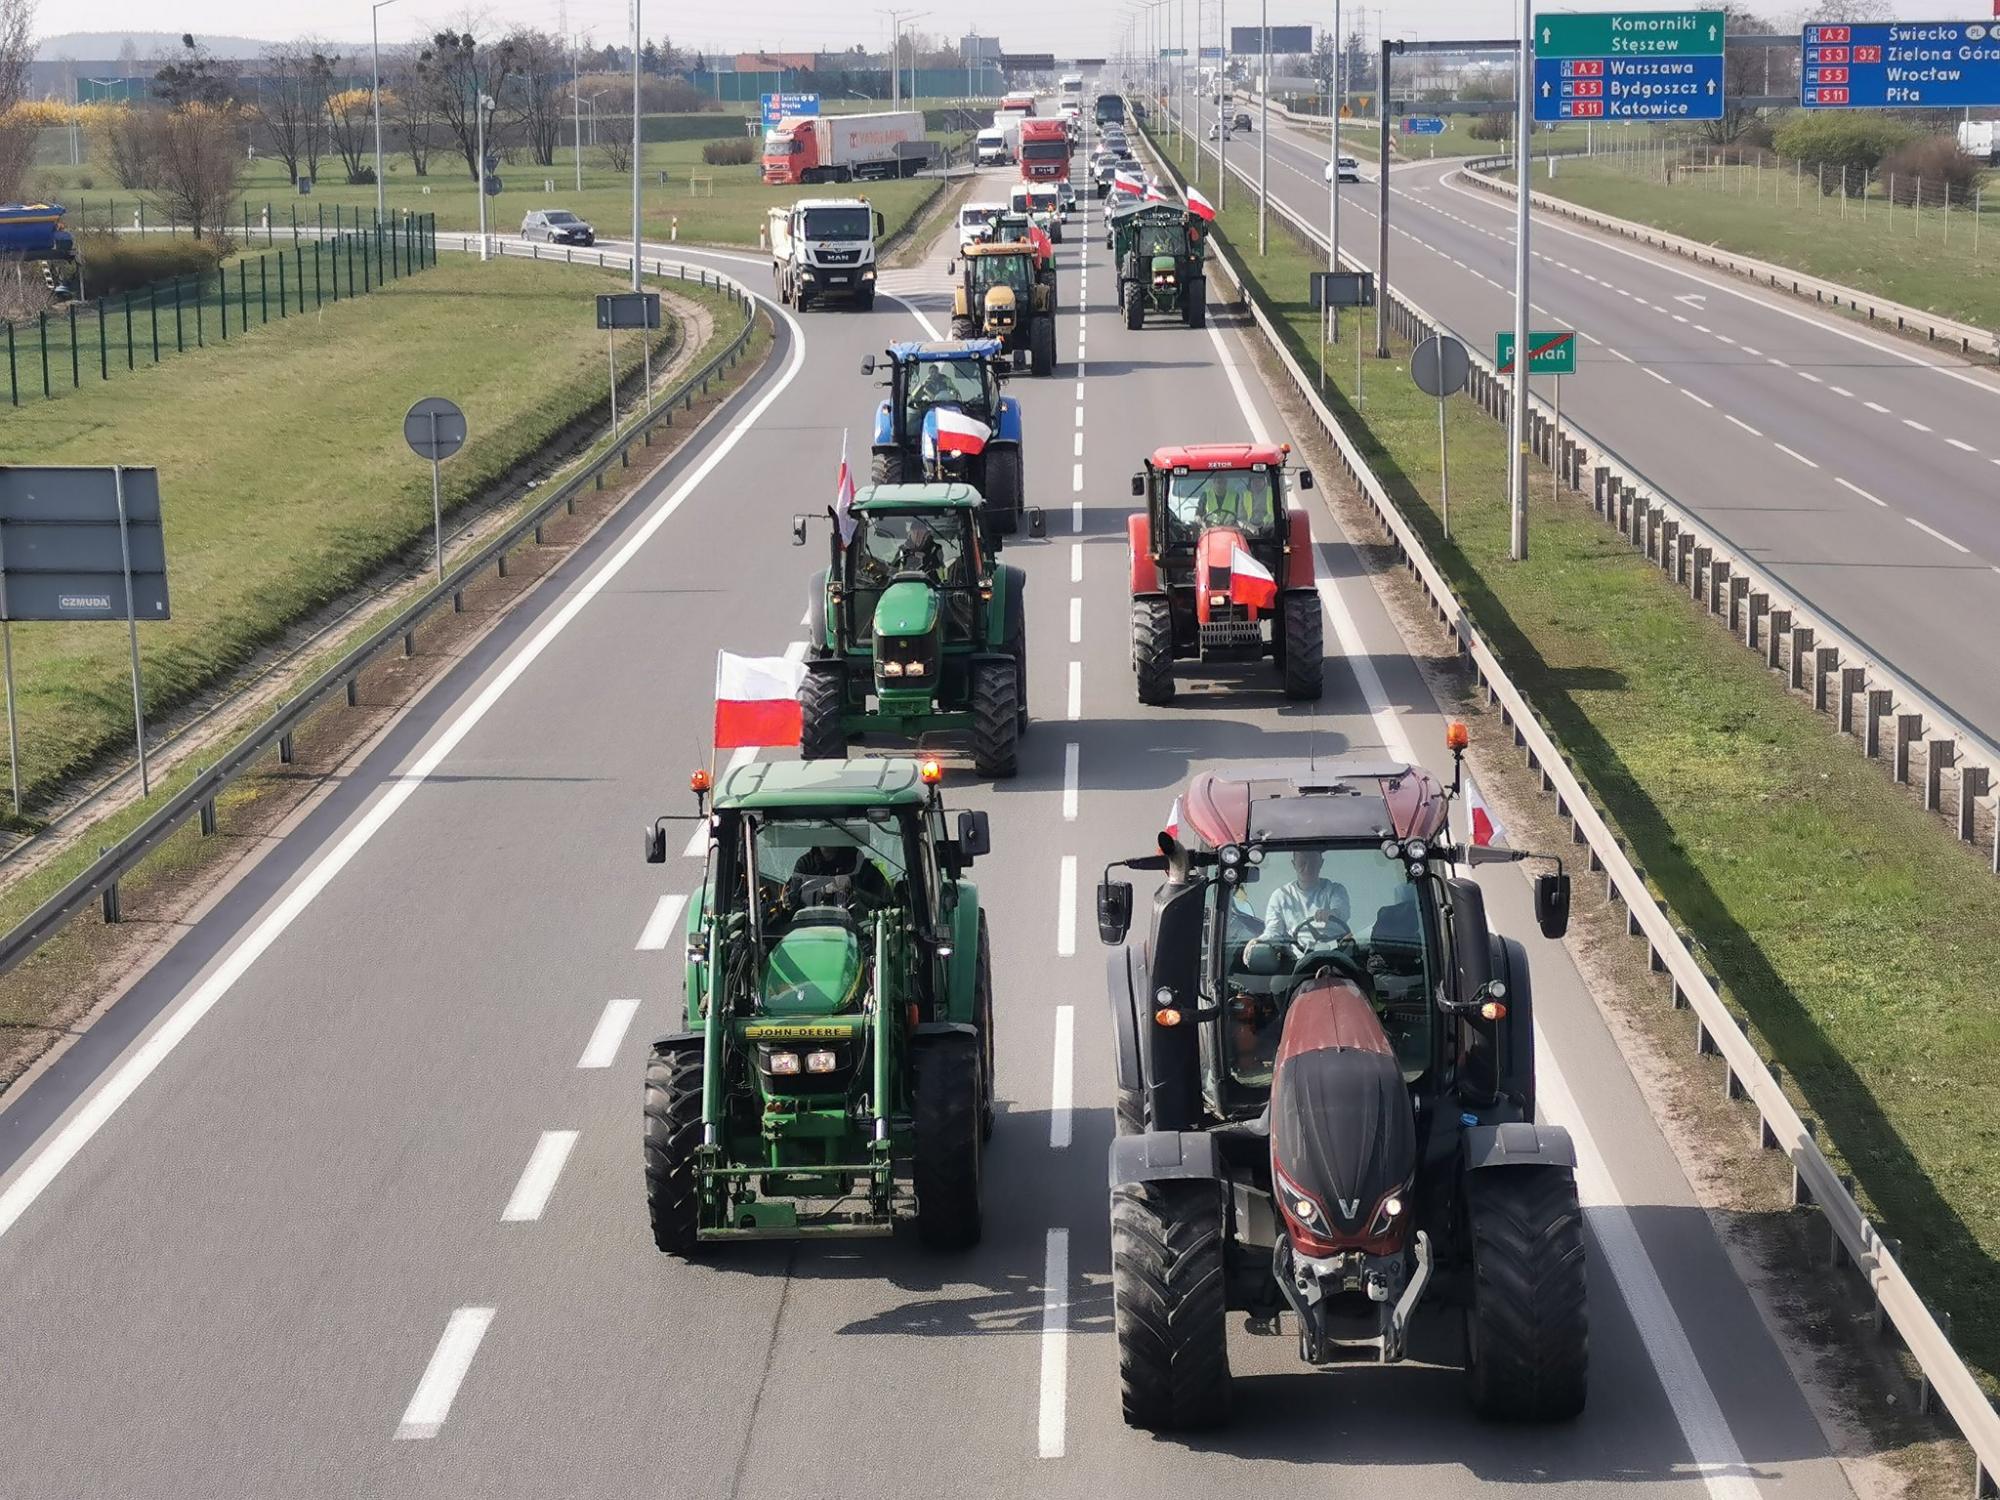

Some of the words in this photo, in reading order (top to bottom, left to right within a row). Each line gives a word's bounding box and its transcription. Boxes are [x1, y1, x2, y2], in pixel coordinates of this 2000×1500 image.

[1612, 16, 1697, 31] Komorniki
[1889, 23, 1958, 41] Świecko
[1970, 28, 1982, 37] PL
[1612, 37, 1679, 54] Stęszew
[1859, 49, 1875, 60] 32
[1888, 47, 1951, 61] Zielona
[1959, 45, 2000, 60] Góra
[1610, 61, 1694, 75] Warszawa
[1887, 67, 1961, 81] Wrocław
[1610, 81, 1698, 98] Bydgoszcz
[1887, 88, 1920, 101] Piła
[1610, 100, 1688, 115] Katowice
[61, 597, 108, 607] CZMUDA
[758, 1028, 792, 1036] JOHN
[799, 1028, 841, 1036] DEERE
